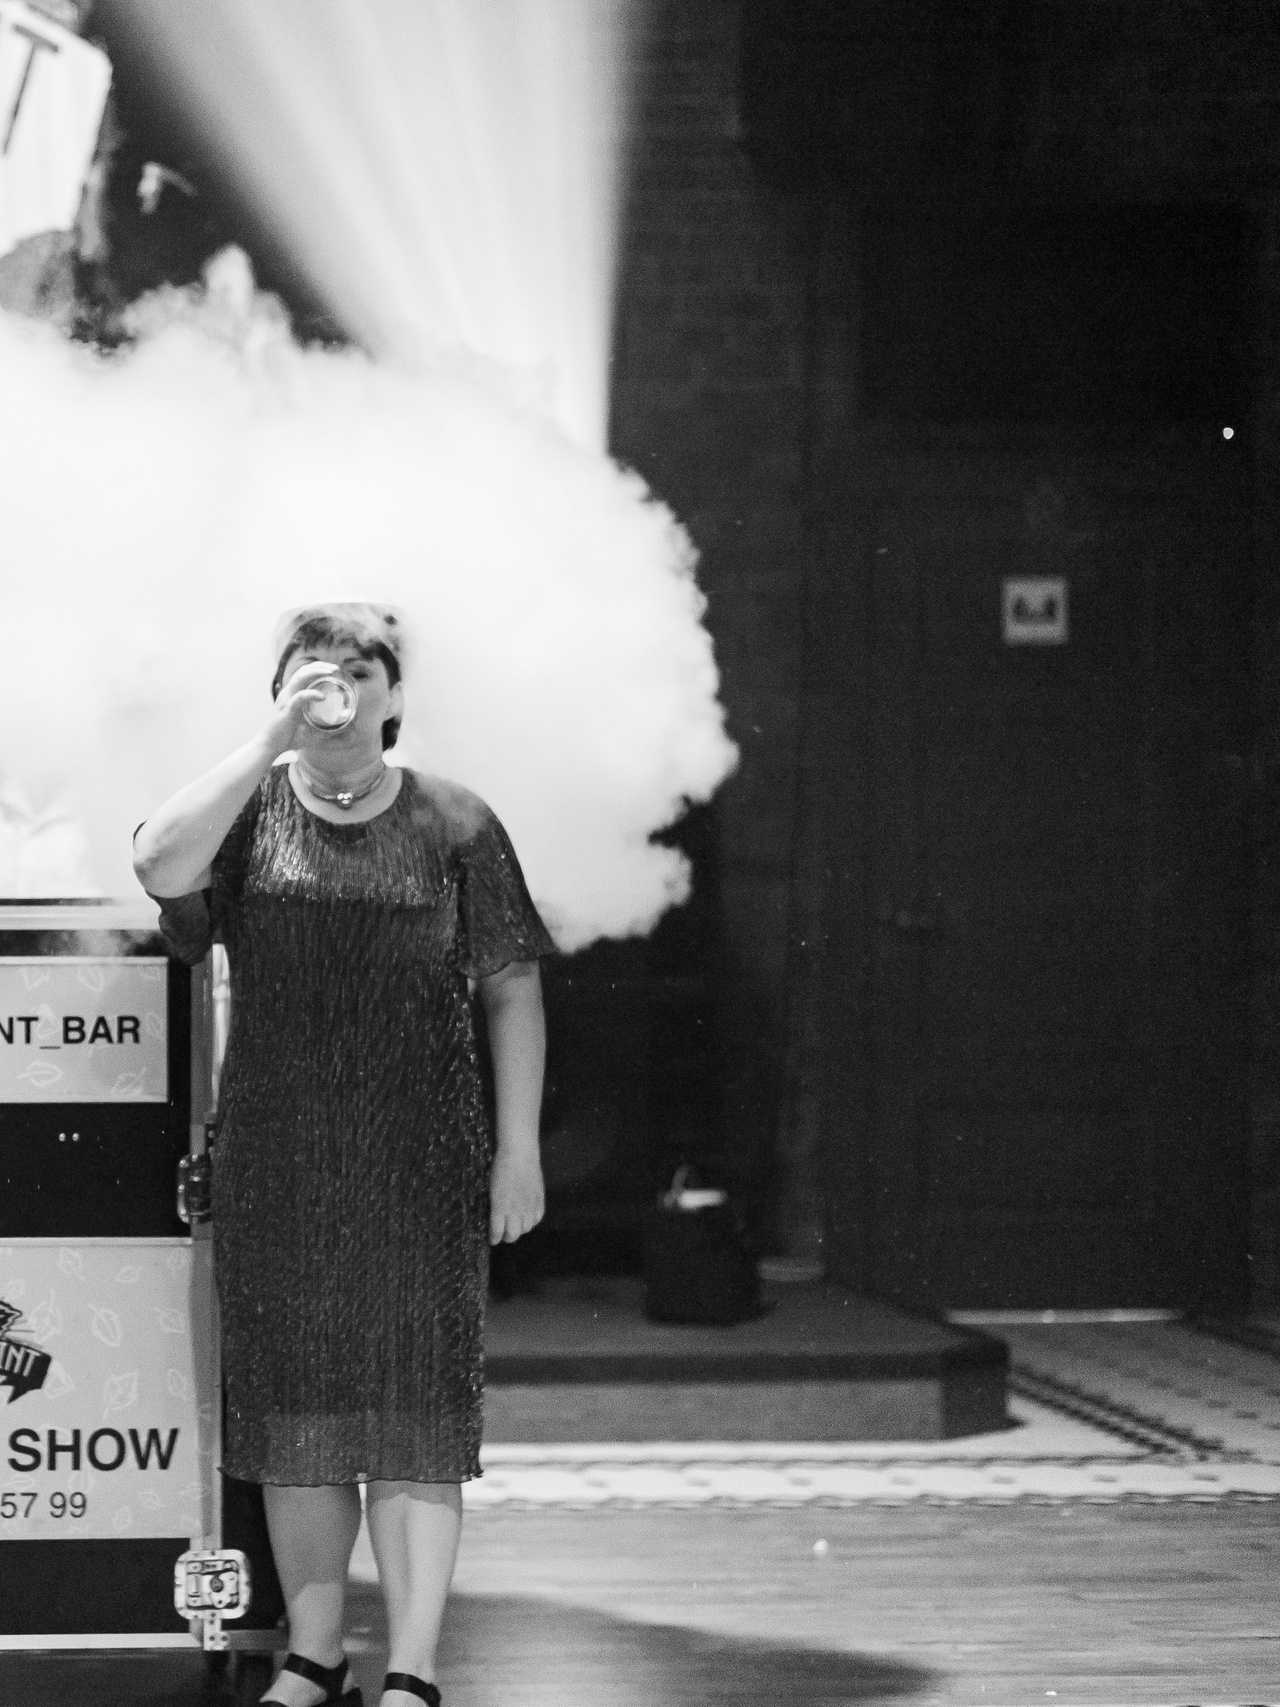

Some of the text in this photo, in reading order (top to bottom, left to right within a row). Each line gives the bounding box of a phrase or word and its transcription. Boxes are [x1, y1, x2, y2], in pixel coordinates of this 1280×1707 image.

[7, 1427, 180, 1472] SHOW
[0, 1492, 38, 1519] 57
[49, 1491, 88, 1519] 99
